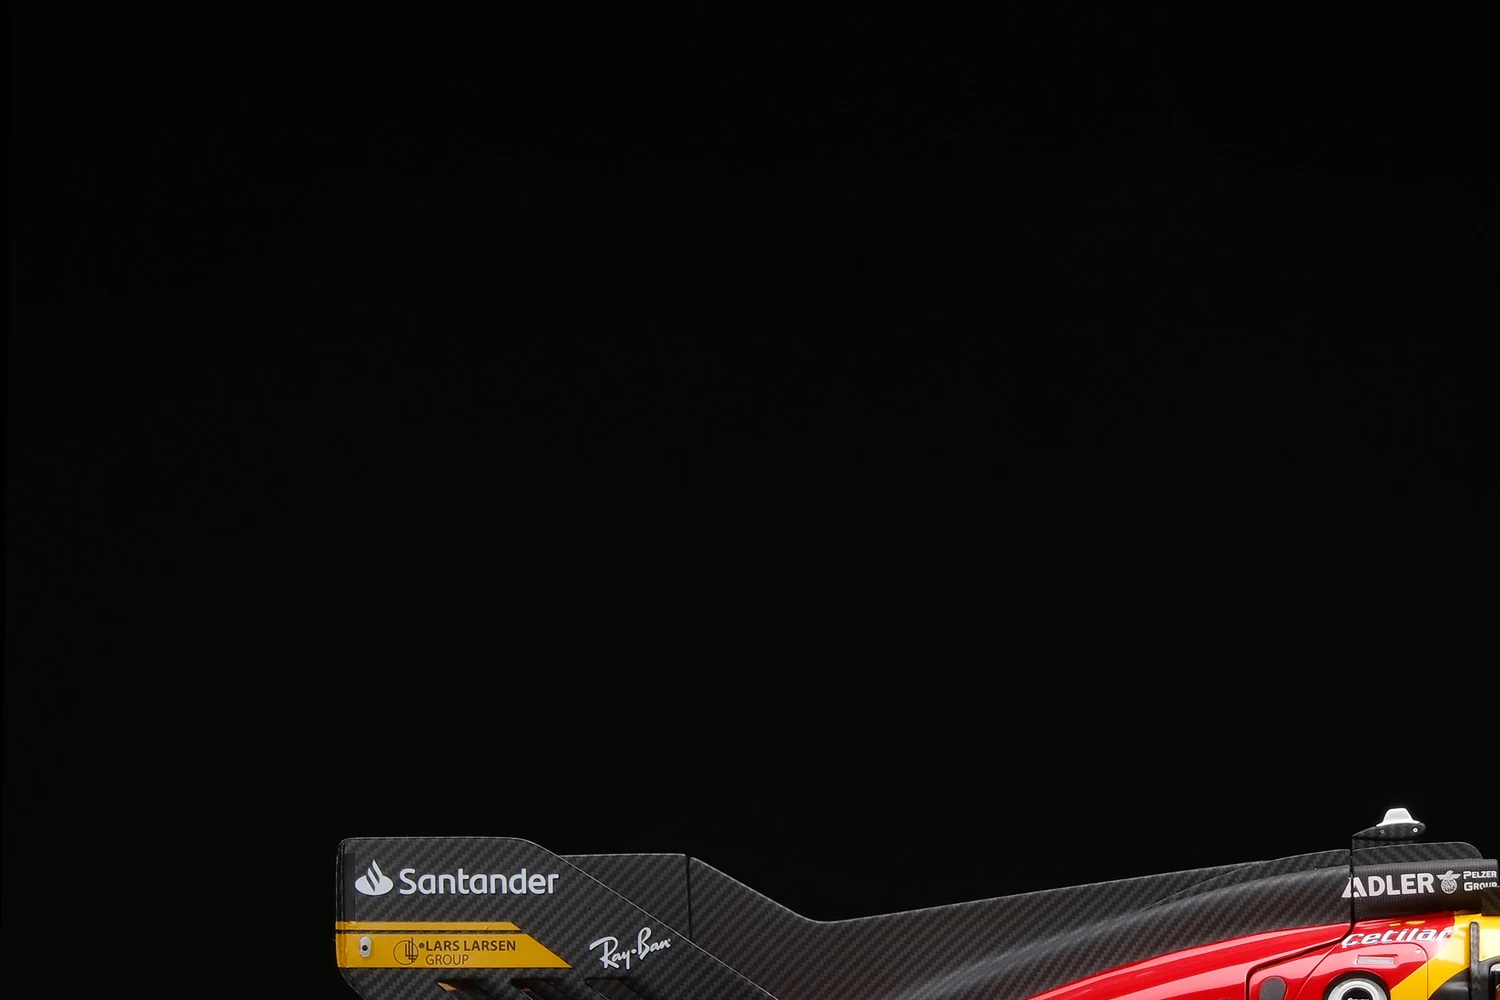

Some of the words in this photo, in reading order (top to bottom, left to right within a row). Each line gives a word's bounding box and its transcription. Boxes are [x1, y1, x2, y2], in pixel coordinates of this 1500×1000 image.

[1463, 870, 1498, 879] PELZER
[399, 868, 560, 895] Santander
[1341, 872, 1435, 898] ADLER
[425, 940, 460, 951] LARS
[463, 939, 516, 951] LARSEN
[425, 954, 469, 965] GROUP
